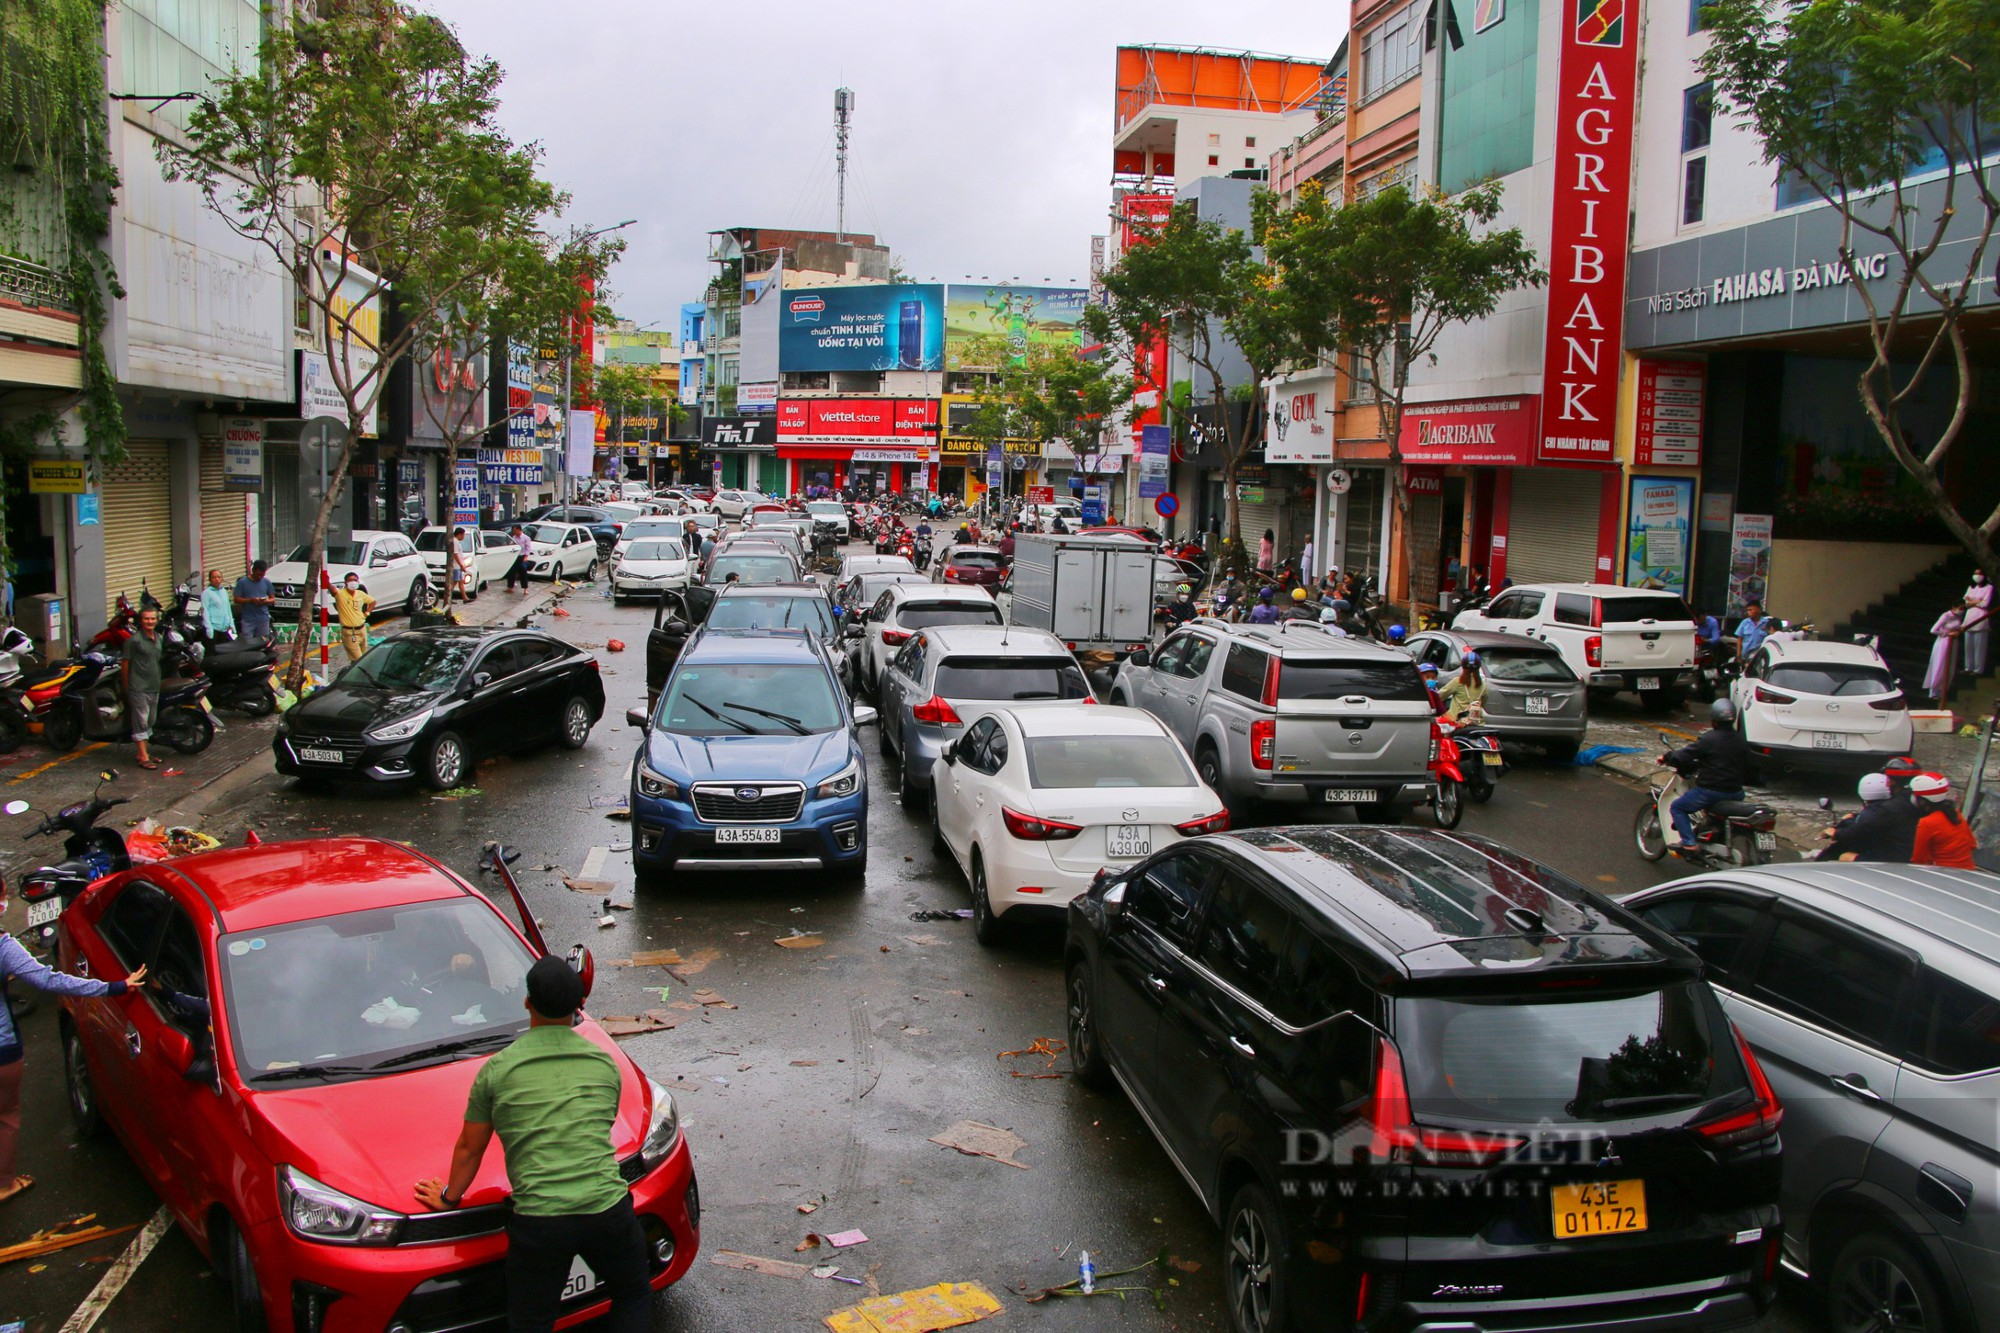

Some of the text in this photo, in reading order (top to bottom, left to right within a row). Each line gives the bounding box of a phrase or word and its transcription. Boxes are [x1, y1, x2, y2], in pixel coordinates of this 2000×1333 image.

[1558, 61, 1616, 422] AGRIBANK
[1648, 294, 1673, 315] Nhà
[1676, 288, 1708, 310] Sách
[1713, 267, 1785, 305] FAHASA
[1793, 259, 1820, 291] ĐÀ
[841, 313, 885, 323] Máy lọc nước
[811, 321, 885, 336] chuẩn TINH KHIẾT
[818, 335, 884, 350] UỐNG TẠI VÒI
[786, 405, 798, 414] BÁN
[908, 405, 924, 414] BÁN
[1292, 392, 1318, 422] GYM
[509, 415, 534, 432] việt
[779, 418, 805, 428] TRẢ GÓP
[820, 411, 880, 422] viettel store
[895, 420, 913, 430] ĐIỆN
[509, 431, 534, 448] tiến
[1430, 423, 1496, 445] AGRIBANK
[1545, 436, 1556, 449] CHI
[1557, 435, 1577, 450] NHÁNH
[1579, 437, 1590, 451] TÂN
[505, 450, 522, 463] VES
[524, 450, 541, 463] TON
[878, 451, 901, 459] iPhone
[486, 467, 542, 484] việt tiến
[1410, 477, 1440, 491] ATM
[1646, 489, 1675, 498] FAHASA
[455, 513, 477, 522] ESTON
[717, 829, 779, 842] 43A-554.83
[1117, 826, 1140, 841] 43A
[1109, 841, 1149, 855] 439.00
[1580, 1184, 1619, 1207] 43E
[1565, 1207, 1638, 1234] 011.72
